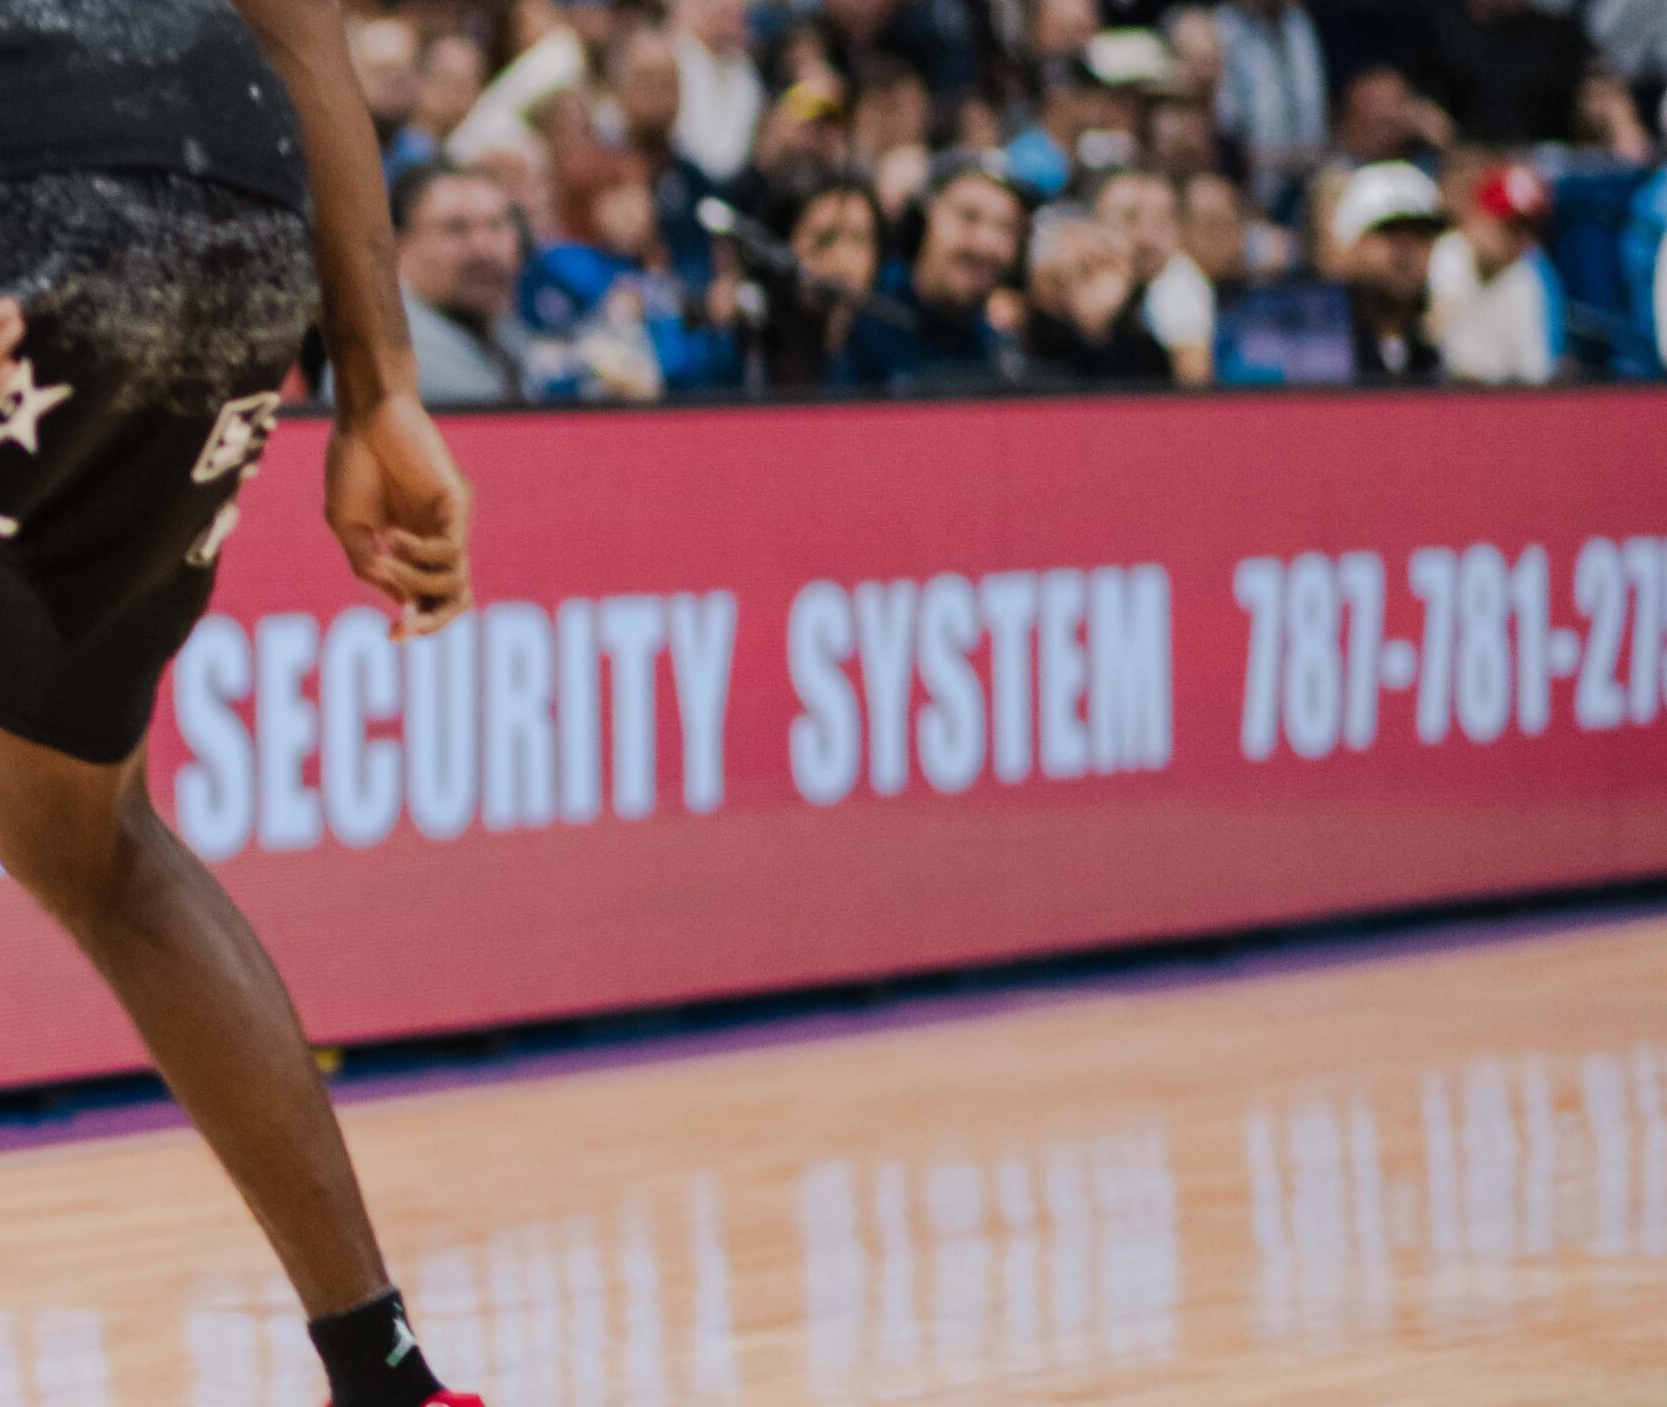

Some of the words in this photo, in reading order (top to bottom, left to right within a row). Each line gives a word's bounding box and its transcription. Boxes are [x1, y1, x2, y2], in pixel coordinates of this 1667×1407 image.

[173, 589, 737, 862] SECURITY
[785, 562, 1172, 806] SYSTEM
[1231, 534, 1667, 762] 787-781-27
